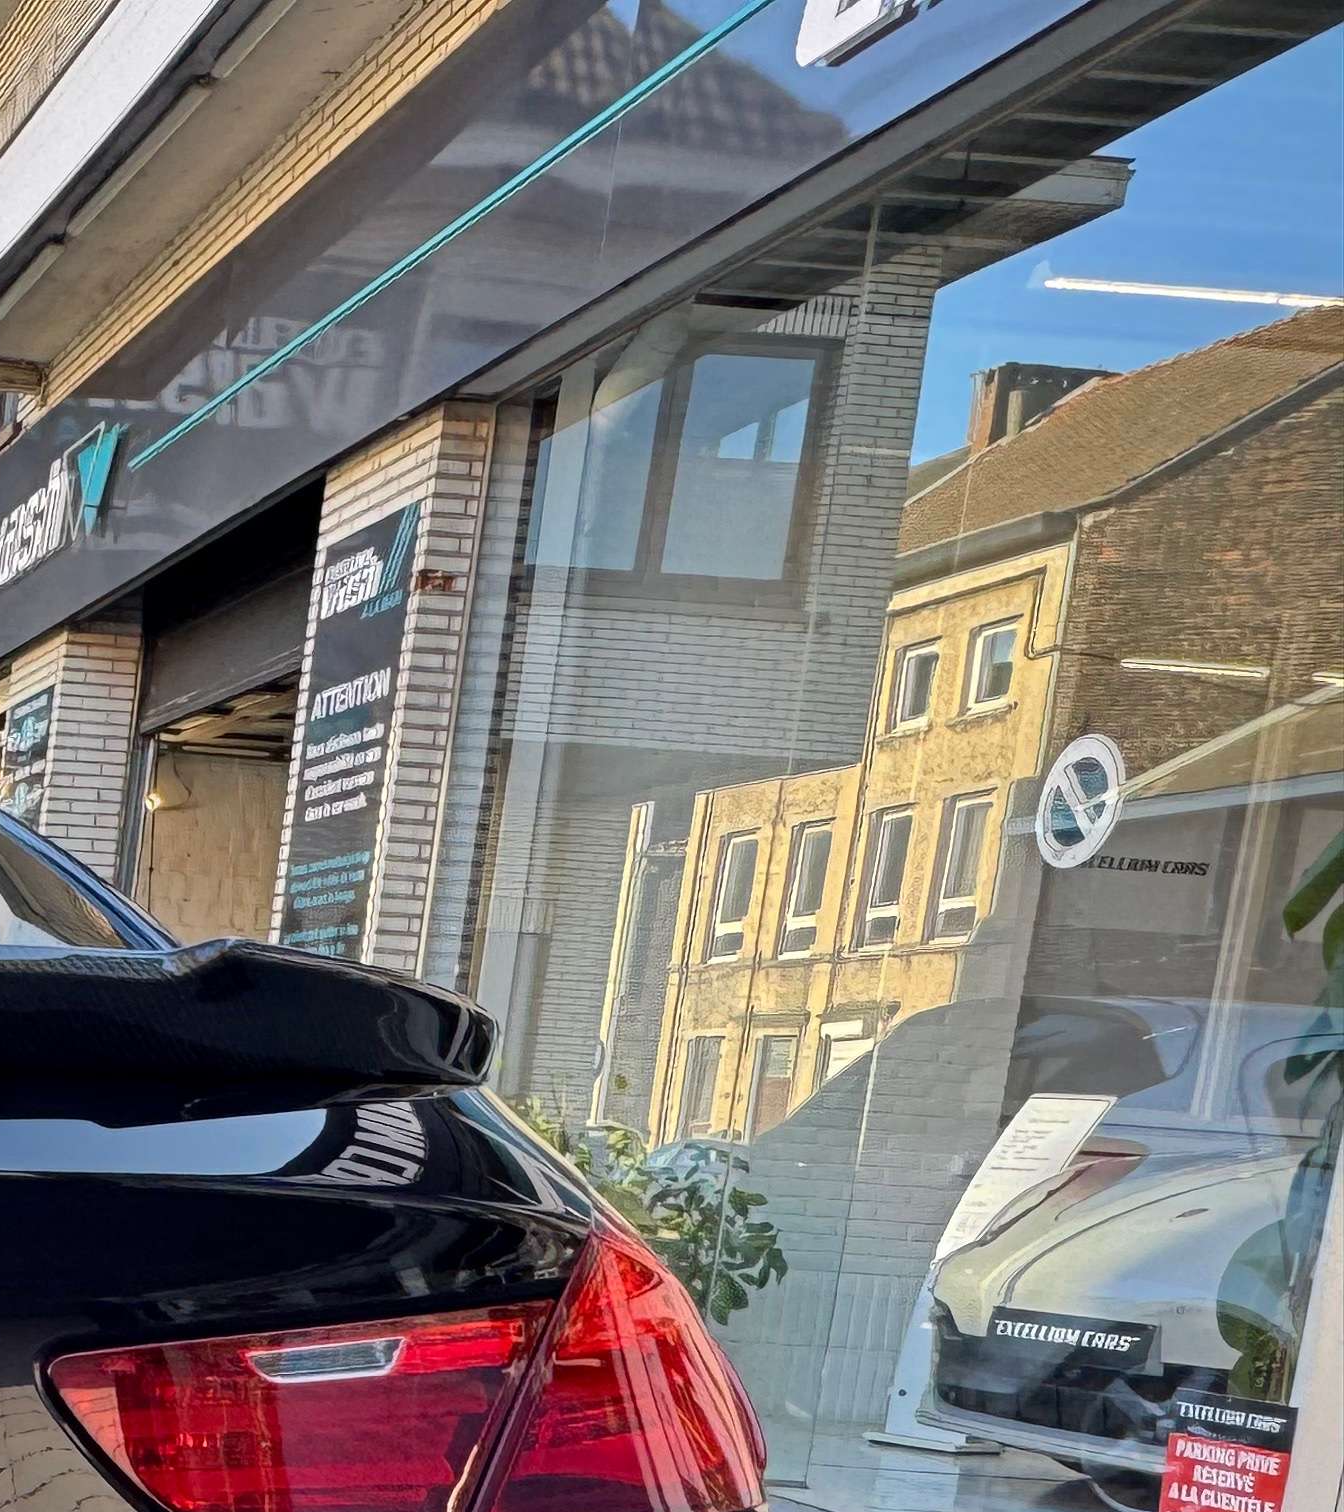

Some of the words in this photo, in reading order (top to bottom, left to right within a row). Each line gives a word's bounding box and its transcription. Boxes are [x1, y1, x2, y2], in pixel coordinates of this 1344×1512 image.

[311, 667, 391, 721] ATTENTION
[1081, 1331, 1141, 1352] CARS
[1175, 1438, 1235, 1467] PARKING
[1181, 1484, 1198, 1505] LA
